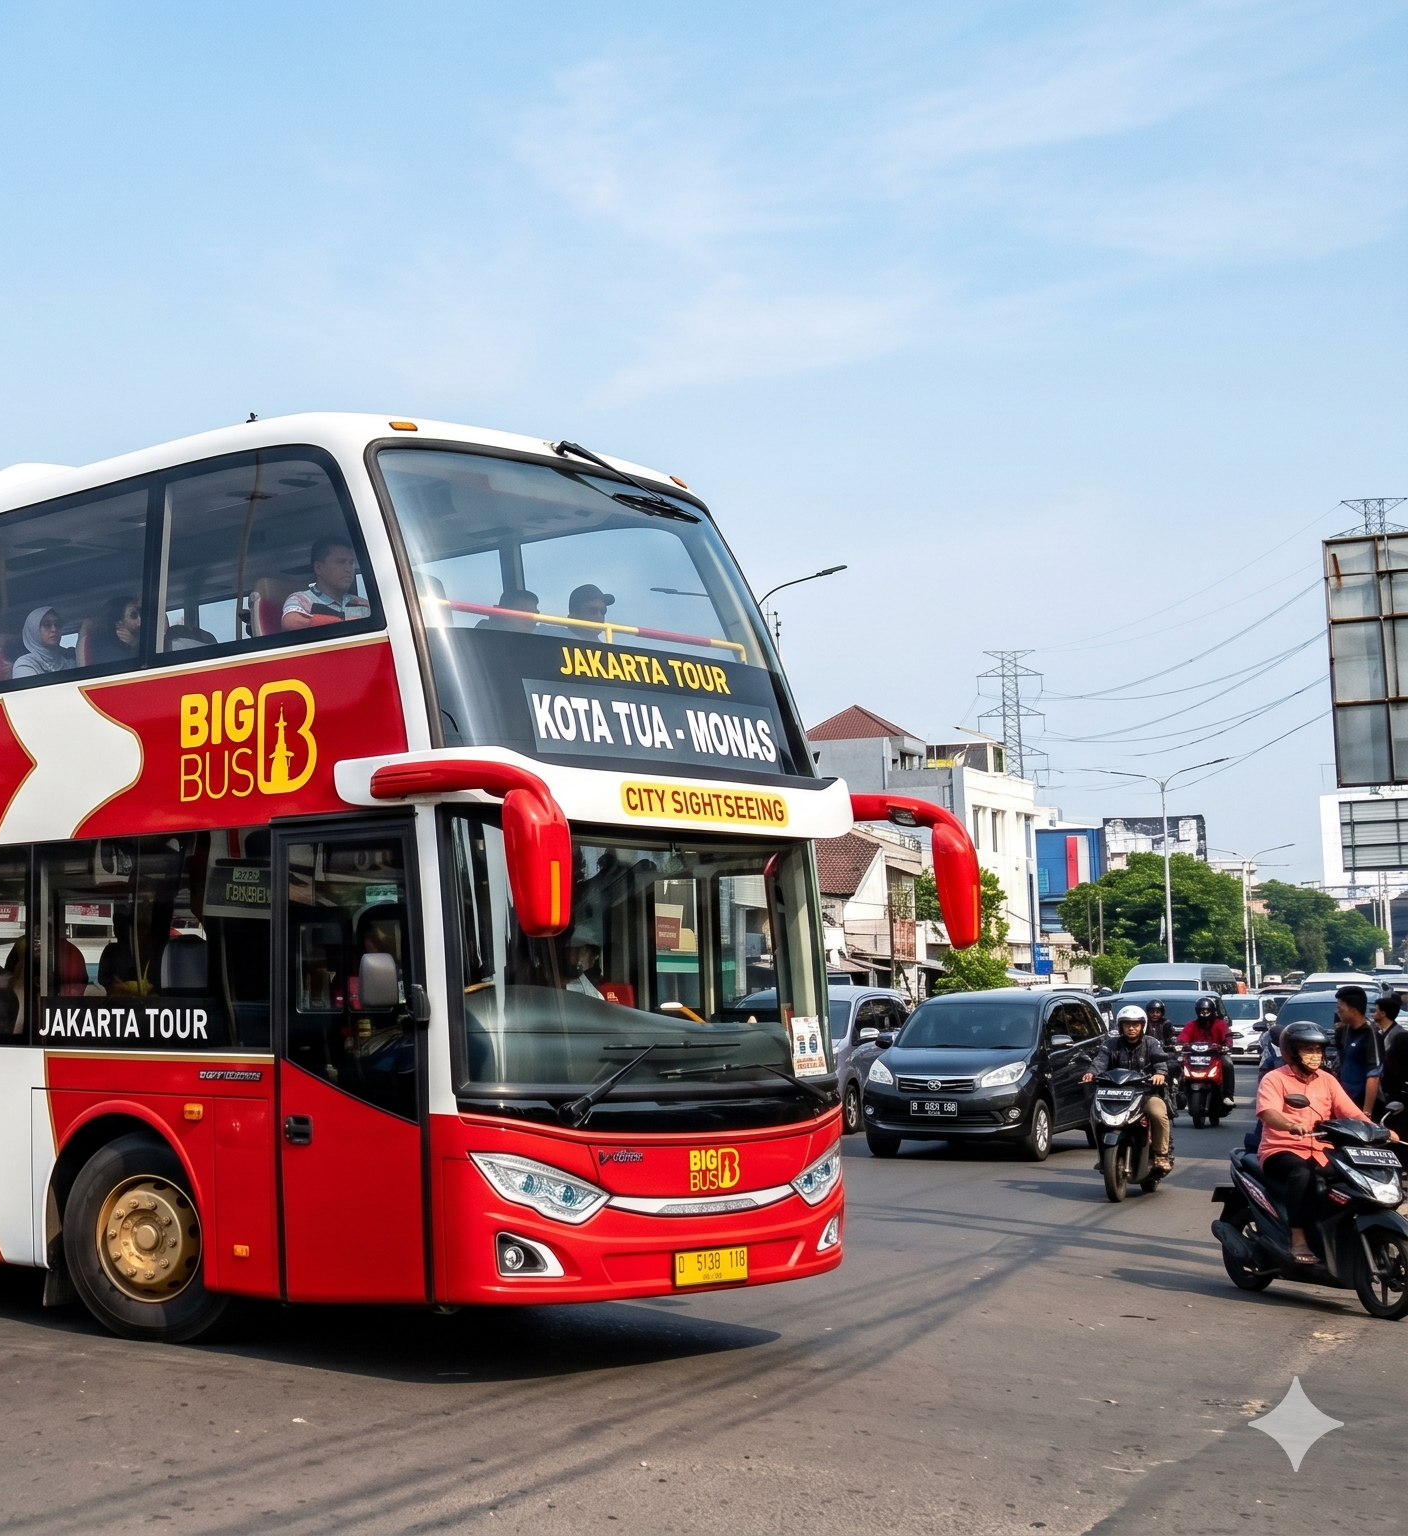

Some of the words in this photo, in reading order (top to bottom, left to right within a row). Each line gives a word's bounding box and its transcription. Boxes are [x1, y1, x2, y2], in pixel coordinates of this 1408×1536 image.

[560, 646, 669, 686] JAKARTA
[668, 659, 731, 695] TOUR
[180, 686, 255, 748] BIG
[531, 693, 614, 744] KOTA
[611, 701, 674, 750] TUA
[685, 709, 777, 763] MONAS
[180, 747, 254, 802] BUS
[625, 787, 667, 813] CITY
[671, 790, 784, 822] SIGHTSEEING
[39, 1008, 140, 1038] JAKARTA
[145, 1008, 208, 1040] TOUR
[690, 1149, 717, 1171] BIG
[690, 1170, 718, 1191] BUS
